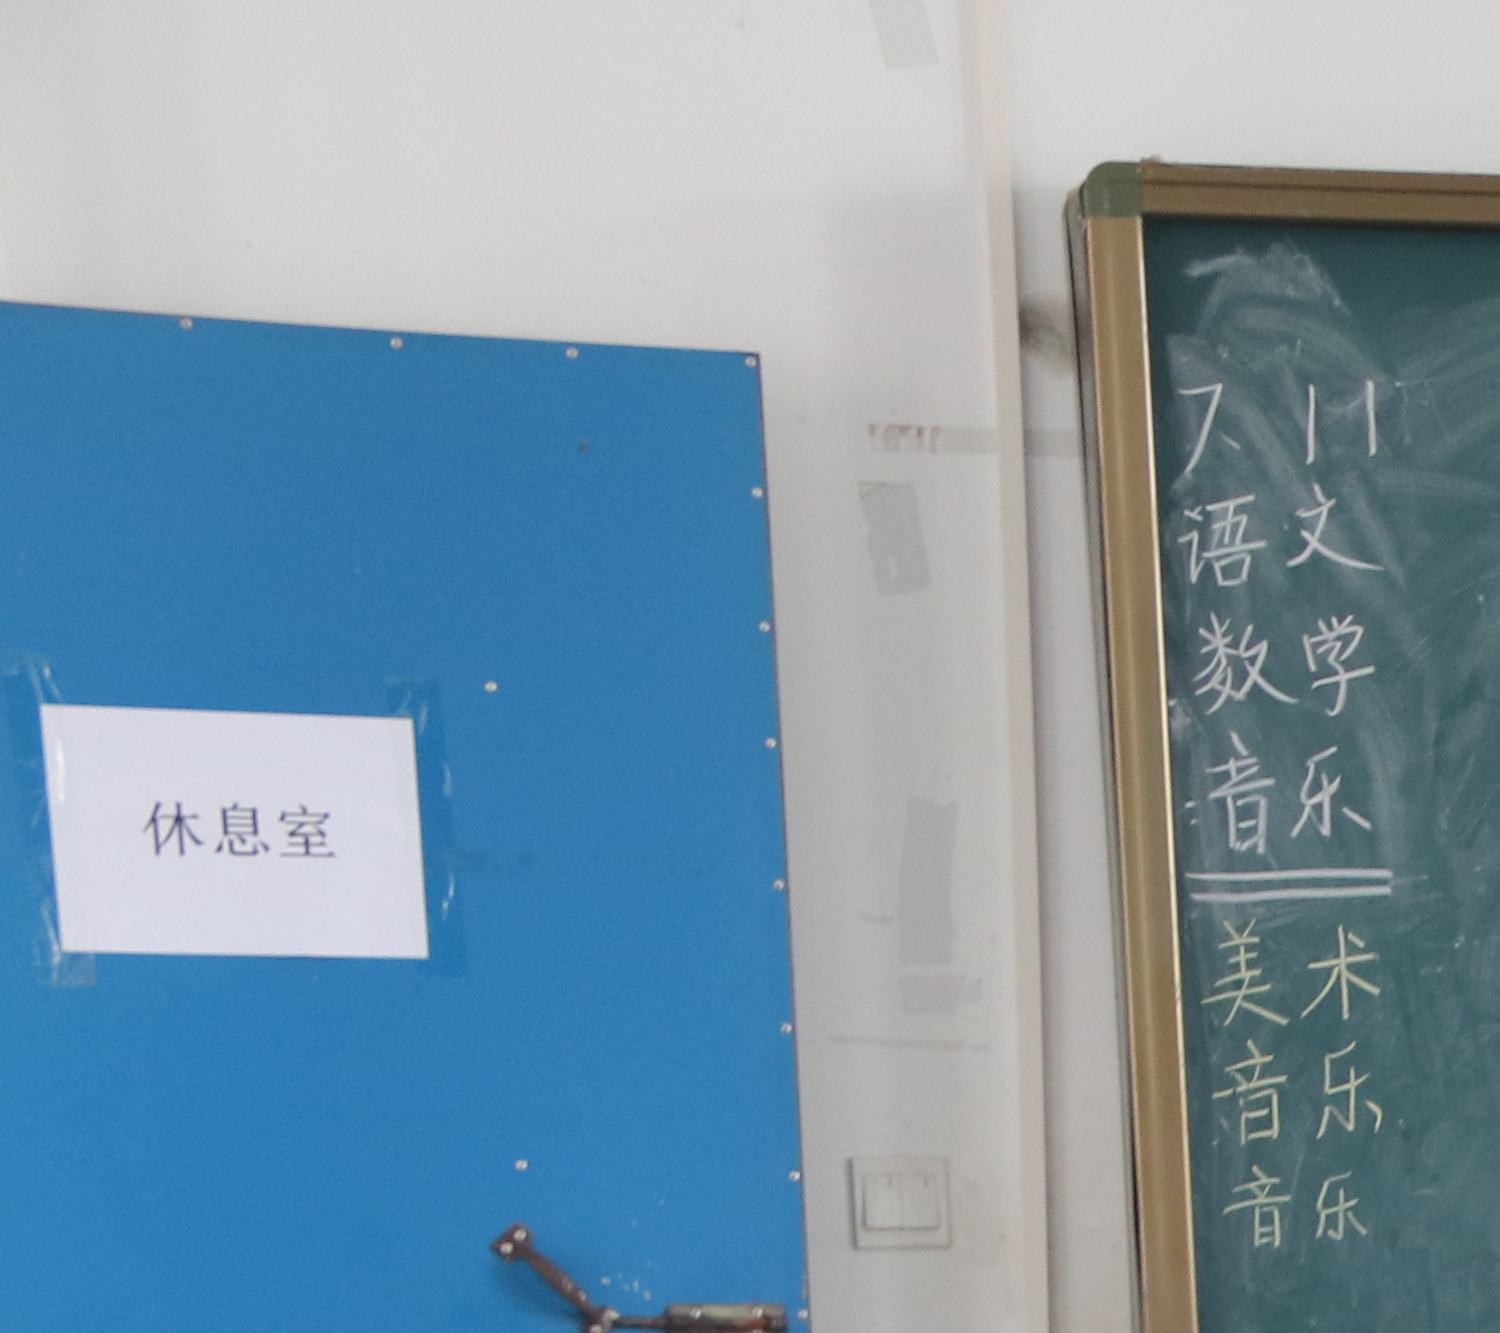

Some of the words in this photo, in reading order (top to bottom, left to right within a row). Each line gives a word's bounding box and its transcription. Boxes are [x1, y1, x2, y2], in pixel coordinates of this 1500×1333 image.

[1177, 483, 1386, 589] 语文
[1193, 612, 1376, 717] 数学
[142, 800, 337, 859] 休息室
[1205, 731, 1372, 855] 音乐
[1201, 917, 1383, 1027] 美术
[1212, 1038, 1383, 1146] 音乐
[1222, 1164, 1369, 1248] 音乐
